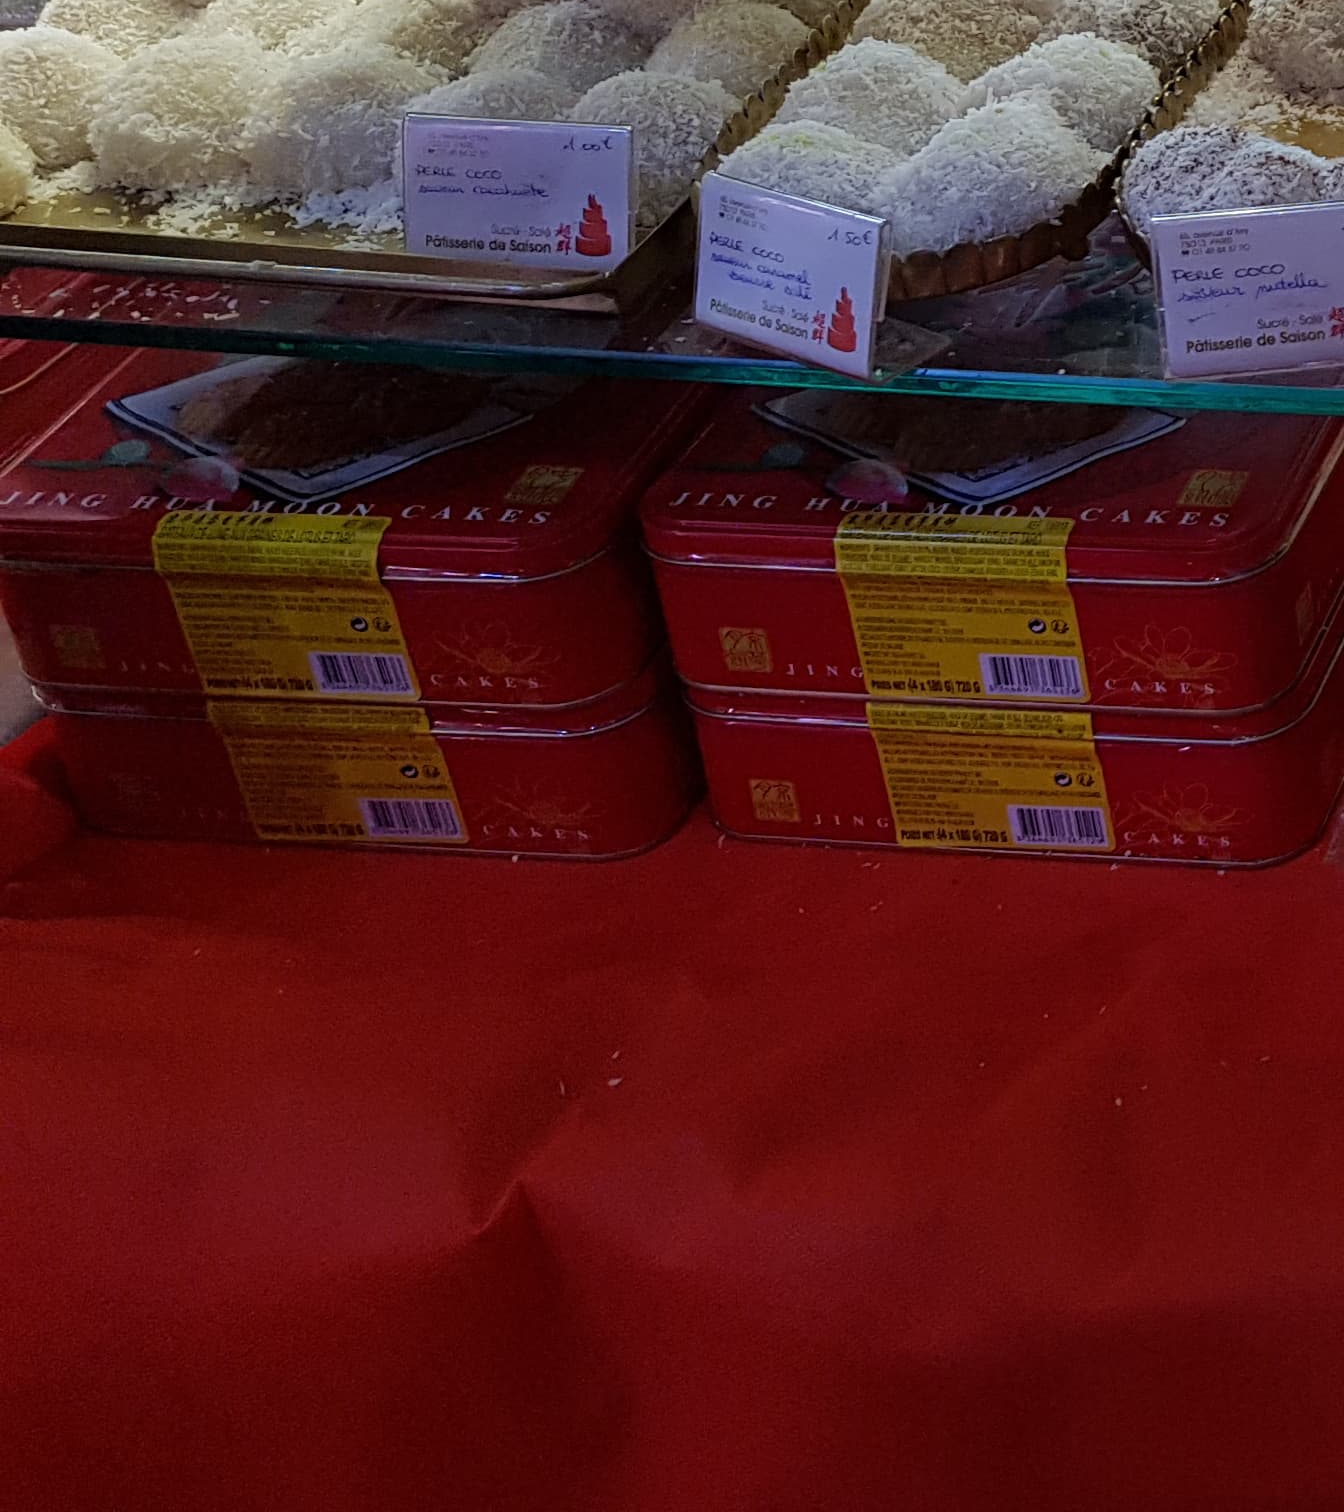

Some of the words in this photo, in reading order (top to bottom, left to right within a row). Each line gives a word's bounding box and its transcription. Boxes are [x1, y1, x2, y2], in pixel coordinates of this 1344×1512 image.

[465, 169, 501, 179] COCO
[425, 235, 484, 250] Pâtisserie
[489, 239, 506, 251] de
[510, 240, 551, 254] Saison
[752, 246, 784, 263] COCO
[1172, 267, 1224, 283] PERLE
[1235, 263, 1285, 279] COCO
[710, 298, 756, 323] Pâtisserie
[759, 315, 772, 329] de
[775, 318, 808, 340] Saison
[1257, 316, 1289, 330] Sucré
[1300, 314, 1323, 326] Salé
[1186, 336, 1252, 353] Pâtisserie
[1257, 333, 1275, 347] de
[1280, 329, 1325, 344] Saison
[0, 491, 108, 509] JING
[129, 495, 216, 512] HUA
[244, 499, 377, 517] MOON
[400, 504, 552, 524] CAKES
[669, 492, 778, 509] JING
[803, 497, 890, 514] HUA
[922, 502, 1052, 518] MOON
[1080, 507, 1230, 528] CAKES
[786, 664, 864, 679] JING
[1104, 679, 1216, 696] CAKES
[1124, 829, 1232, 849] CAKES
